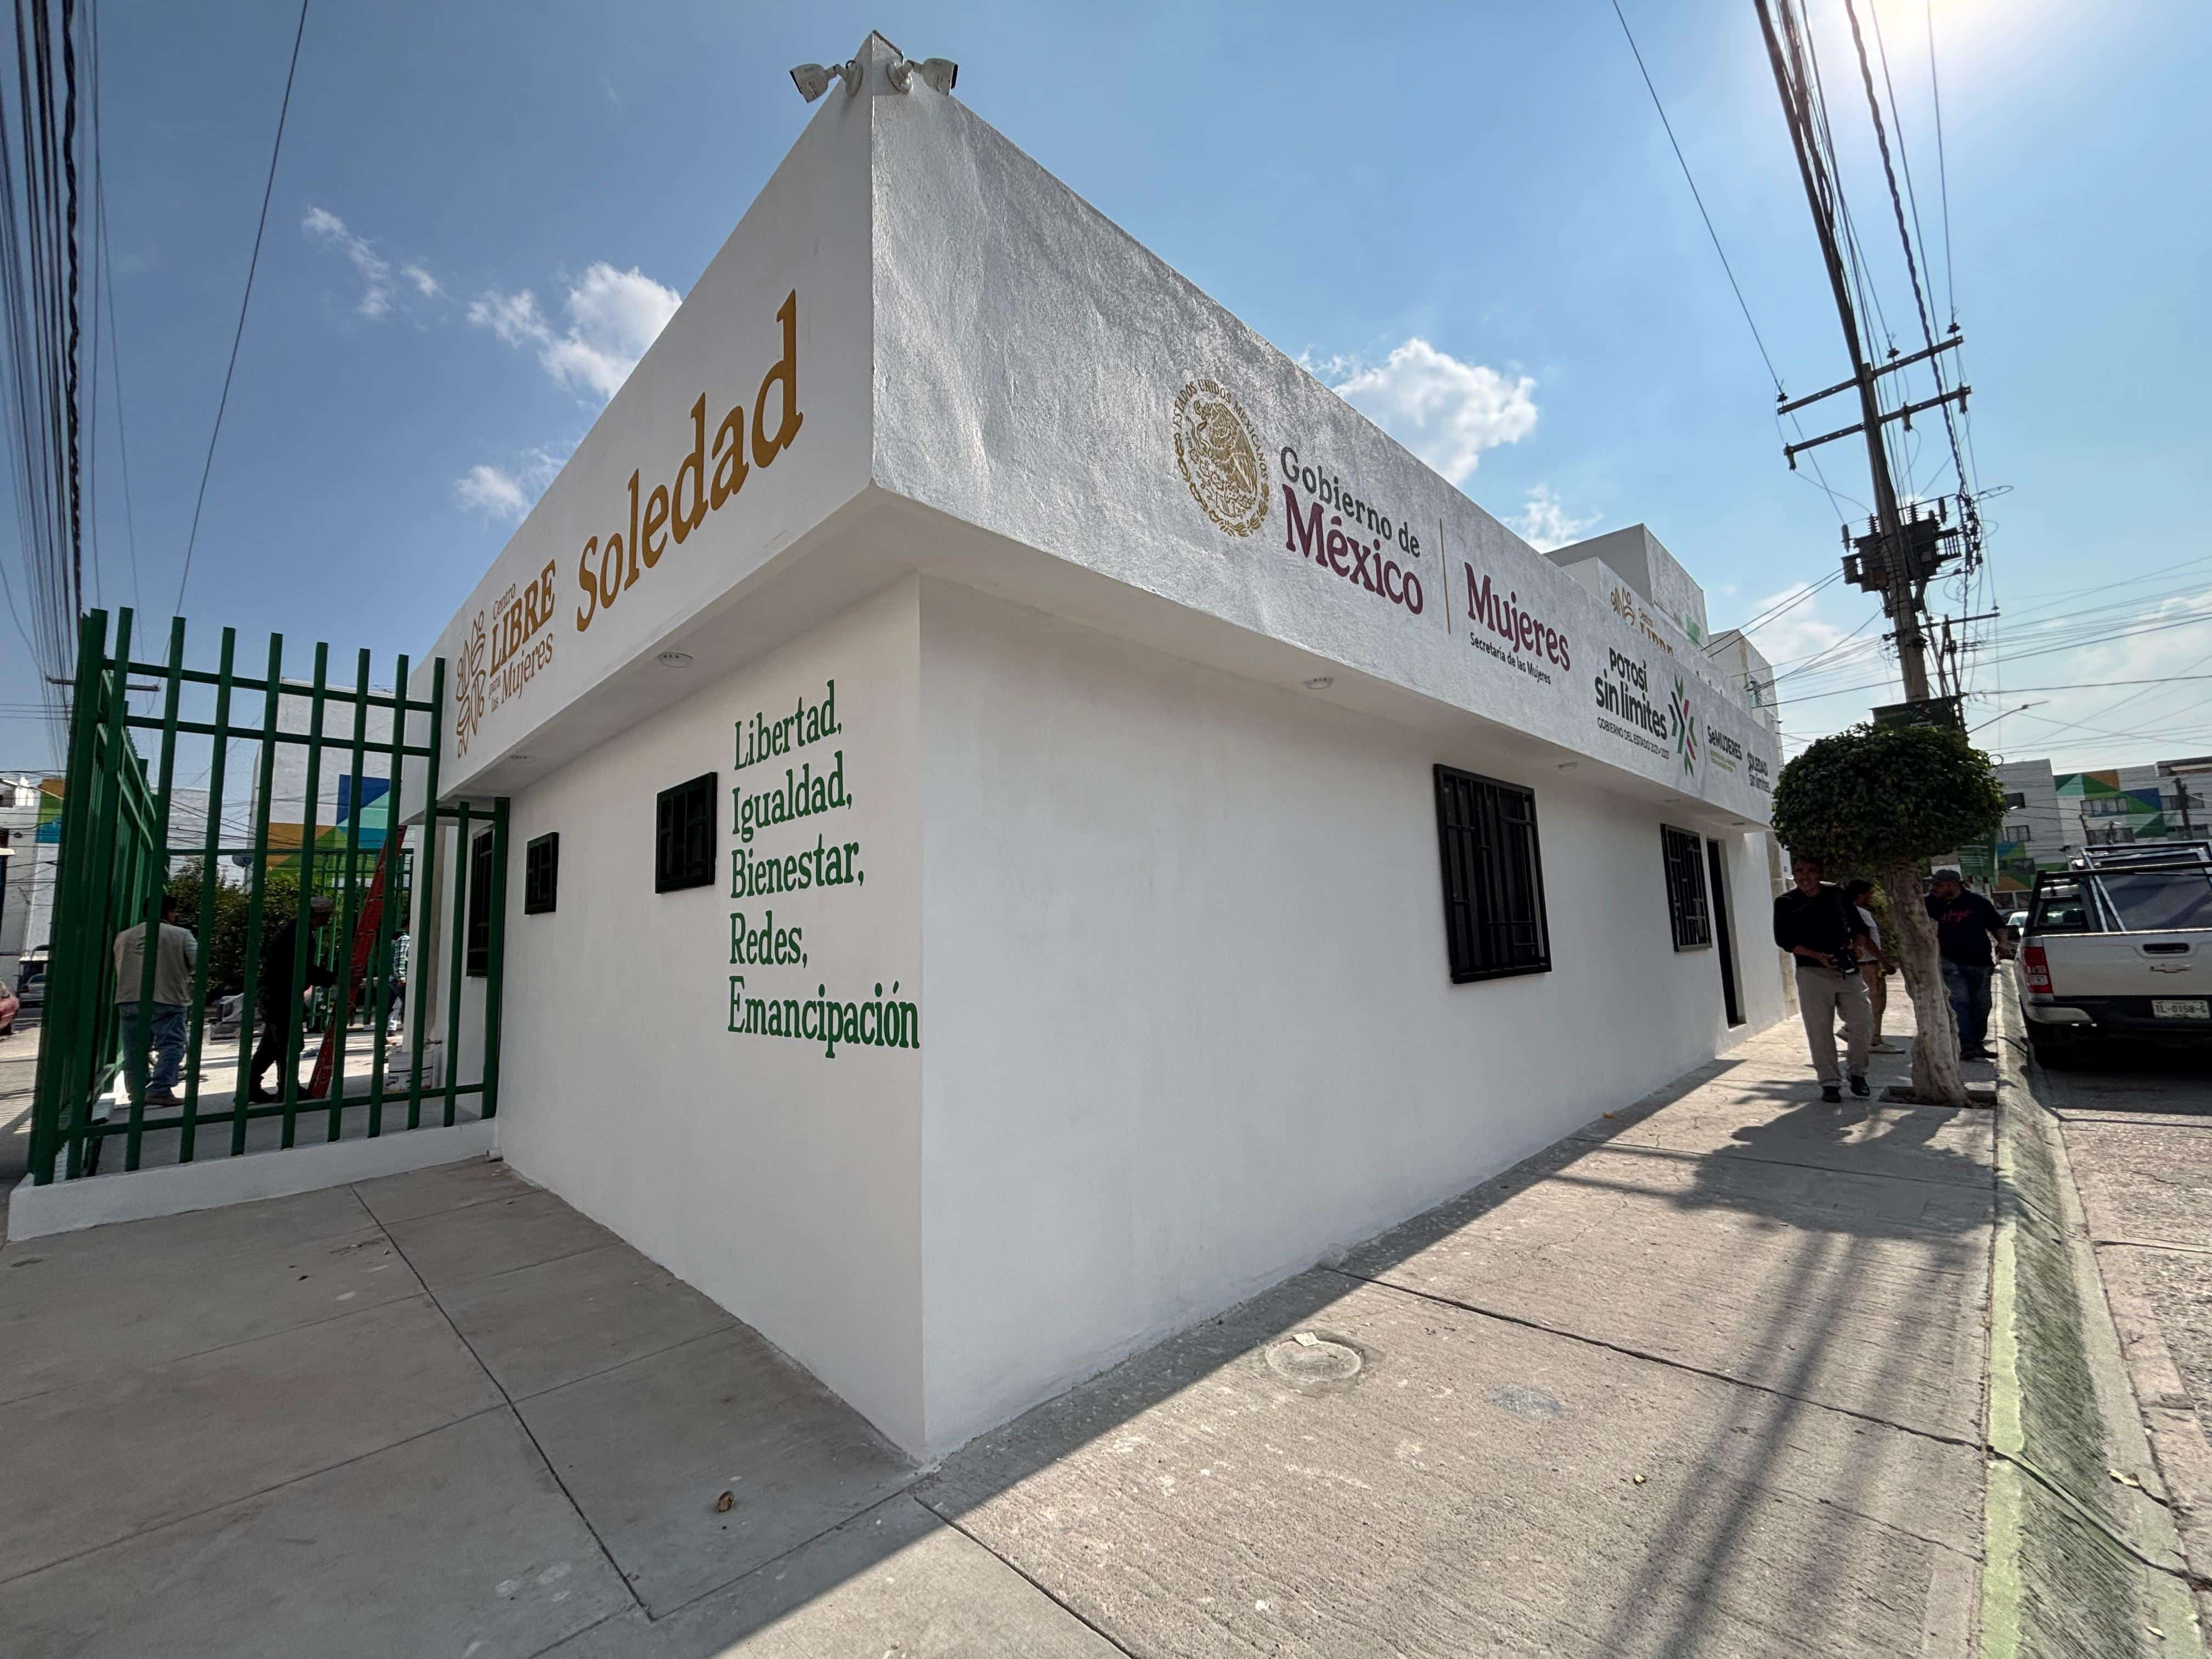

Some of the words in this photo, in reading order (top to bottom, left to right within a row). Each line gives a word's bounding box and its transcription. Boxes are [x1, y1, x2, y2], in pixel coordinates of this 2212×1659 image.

[577, 288, 803, 632] Soledad
[1173, 381, 1197, 429] ESTADOS
[1198, 379, 1231, 404] UNIDOS
[1233, 400, 1268, 480] MEXICANOS
[1280, 447, 1392, 540] Gobierno
[1398, 522, 1420, 557] de
[1282, 483, 1423, 614] México
[489, 558, 556, 678] LIBRE
[494, 583, 516, 620] Centro
[1464, 562, 1570, 672] Mujeres
[488, 675, 501, 699] para
[501, 633, 553, 704] Mujeres
[1470, 632, 1505, 662] Secretaría
[1508, 652, 1515, 667] de
[1517, 656, 1526, 673] las
[1527, 661, 1550, 685] Mujeres
[1595, 668, 1619, 715] sin
[734, 679, 842, 771] Libertad,
[732, 750, 852, 843] Igualdad,
[730, 833, 864, 899] Bienestar,
[730, 910, 808, 969] Redes,
[727, 975, 920, 1059] Emancipación
